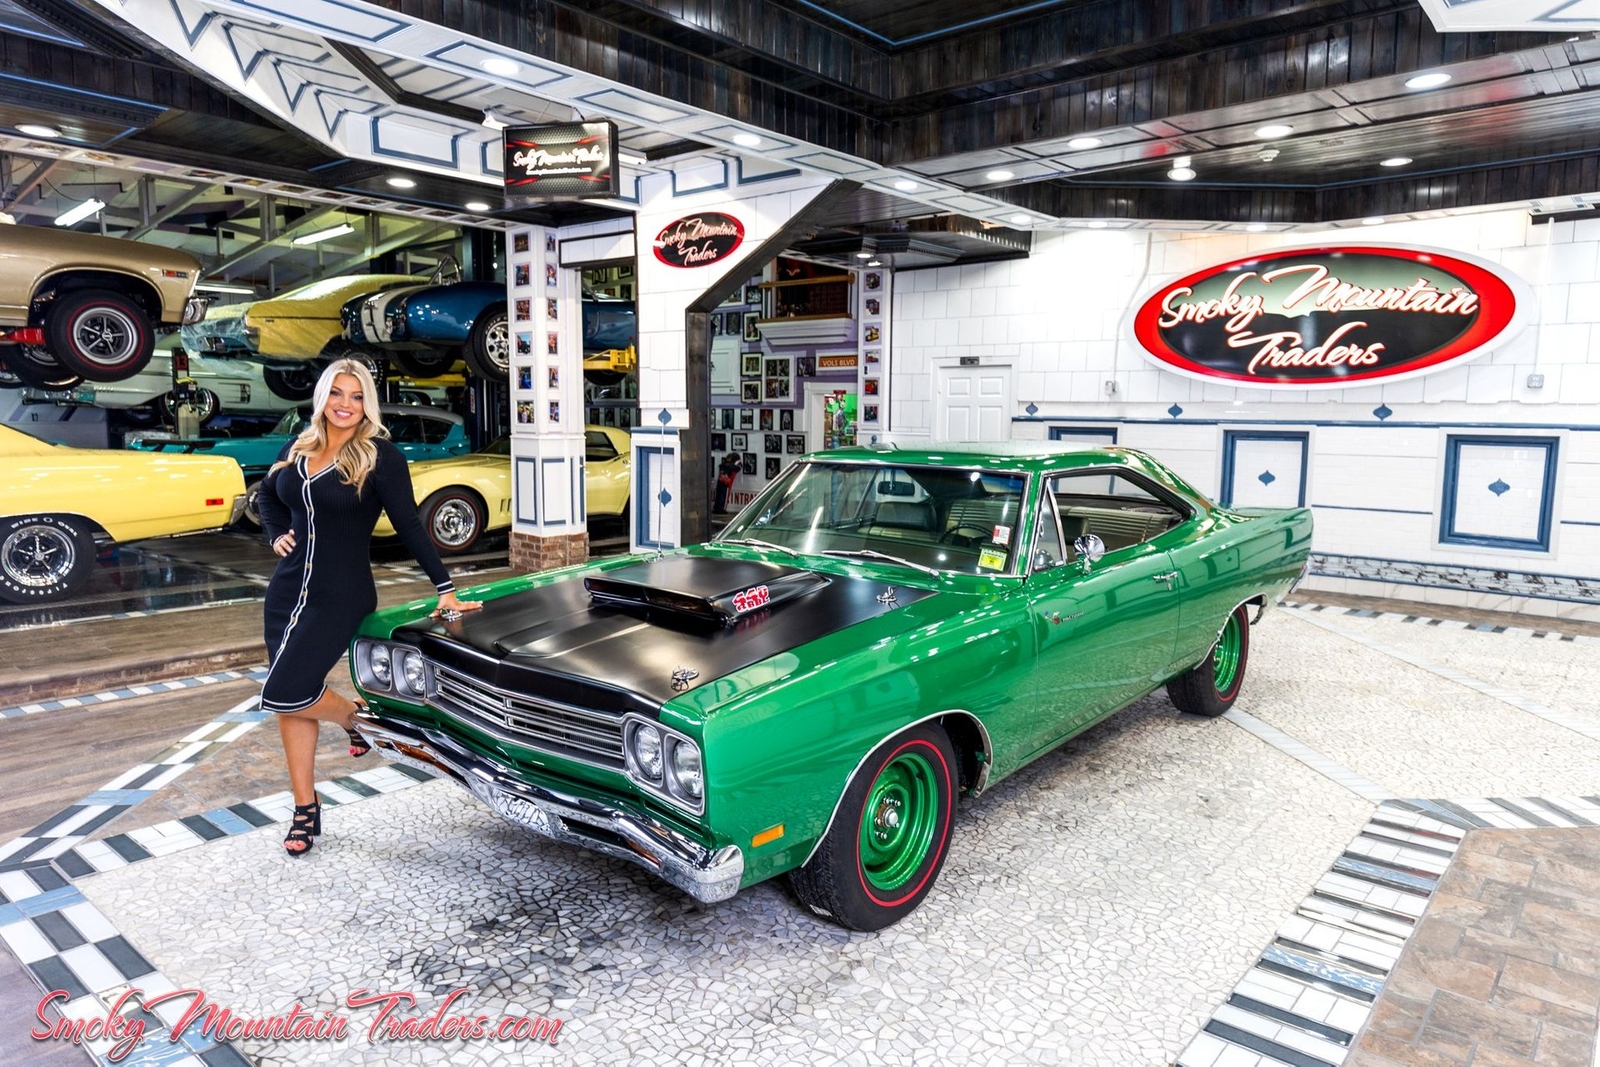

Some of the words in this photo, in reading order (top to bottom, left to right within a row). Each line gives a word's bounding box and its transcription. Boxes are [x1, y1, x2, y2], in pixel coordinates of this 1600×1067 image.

[660, 222, 687, 249] Smoky
[686, 218, 738, 238] Mountain
[678, 240, 718, 266] Traders
[1158, 272, 1265, 333] Smoky
[1261, 264, 1480, 316] Mountain
[1227, 321, 1386, 375] Traders
